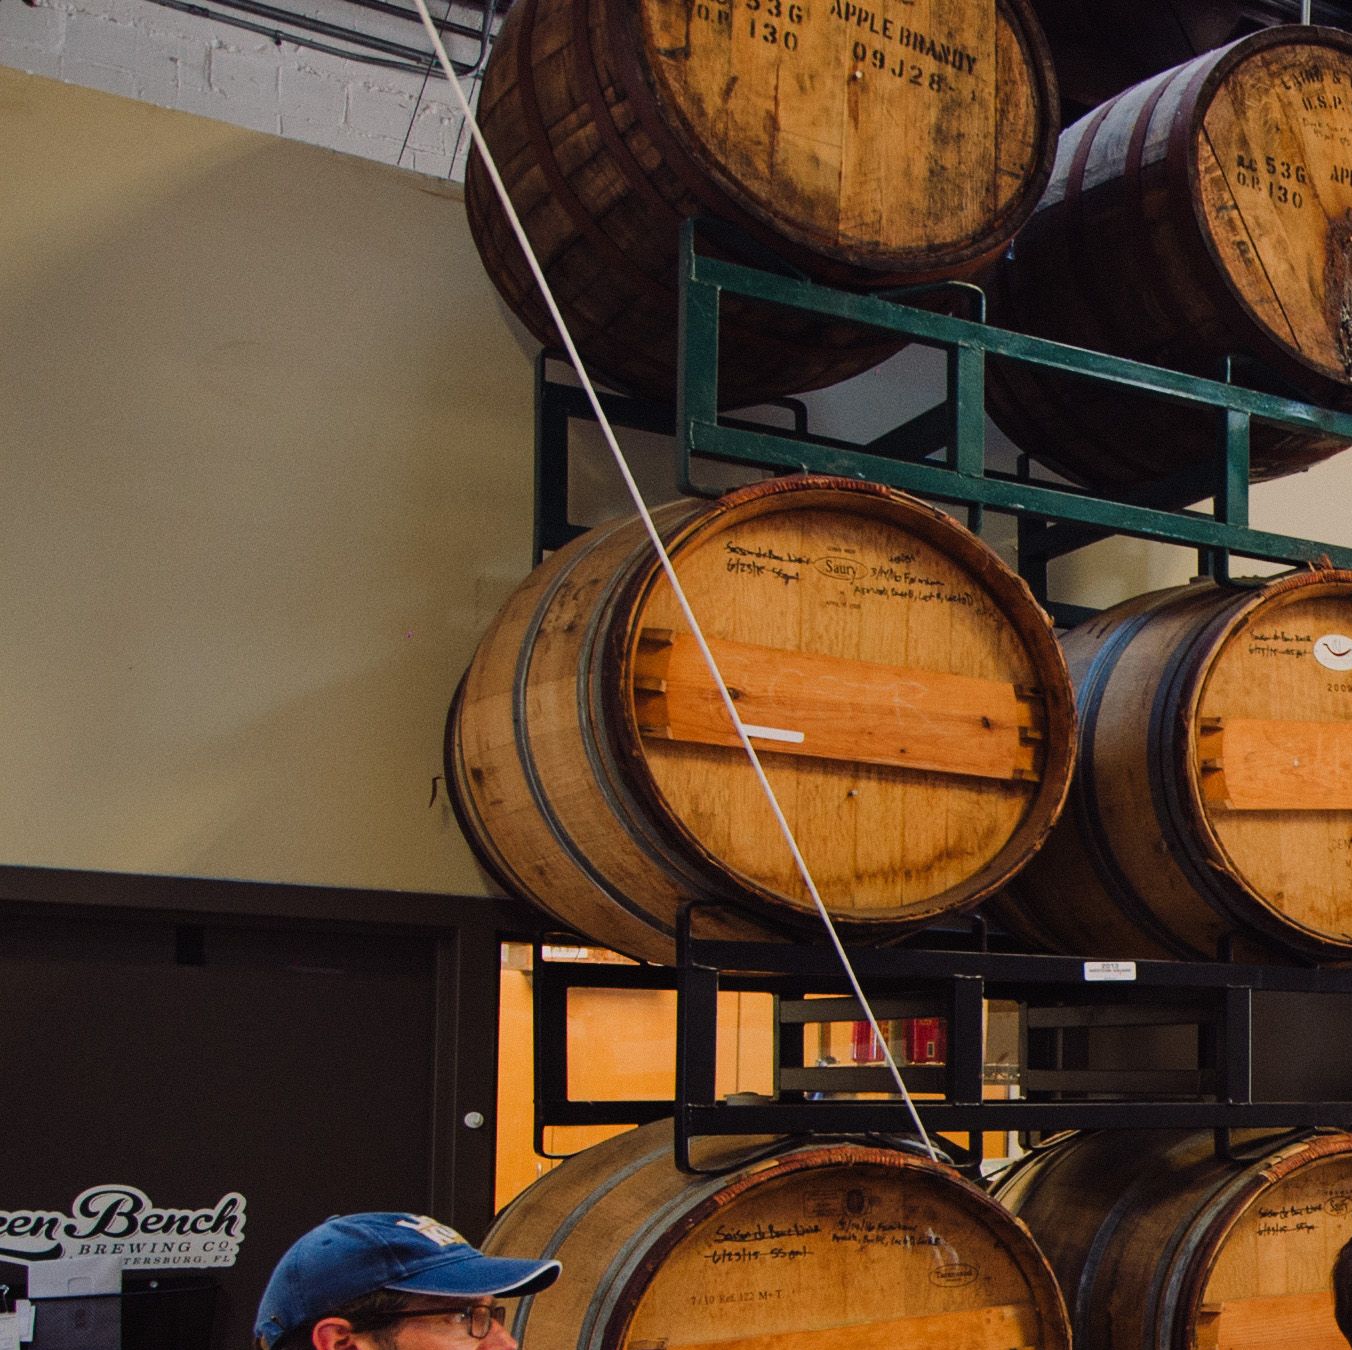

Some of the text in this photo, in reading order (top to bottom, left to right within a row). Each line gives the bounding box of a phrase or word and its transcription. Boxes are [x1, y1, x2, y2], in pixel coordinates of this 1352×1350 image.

[749, 18, 798, 51] 130
[829, 0, 893, 40] APPLE
[899, 26, 976, 75] BRANDY
[1268, 181, 1303, 209] 130
[825, 559, 857, 585] Saury
[64, 1190, 238, 1240] Bench
[79, 1242, 191, 1256] BREWING
[213, 1254, 231, 1264] FL
